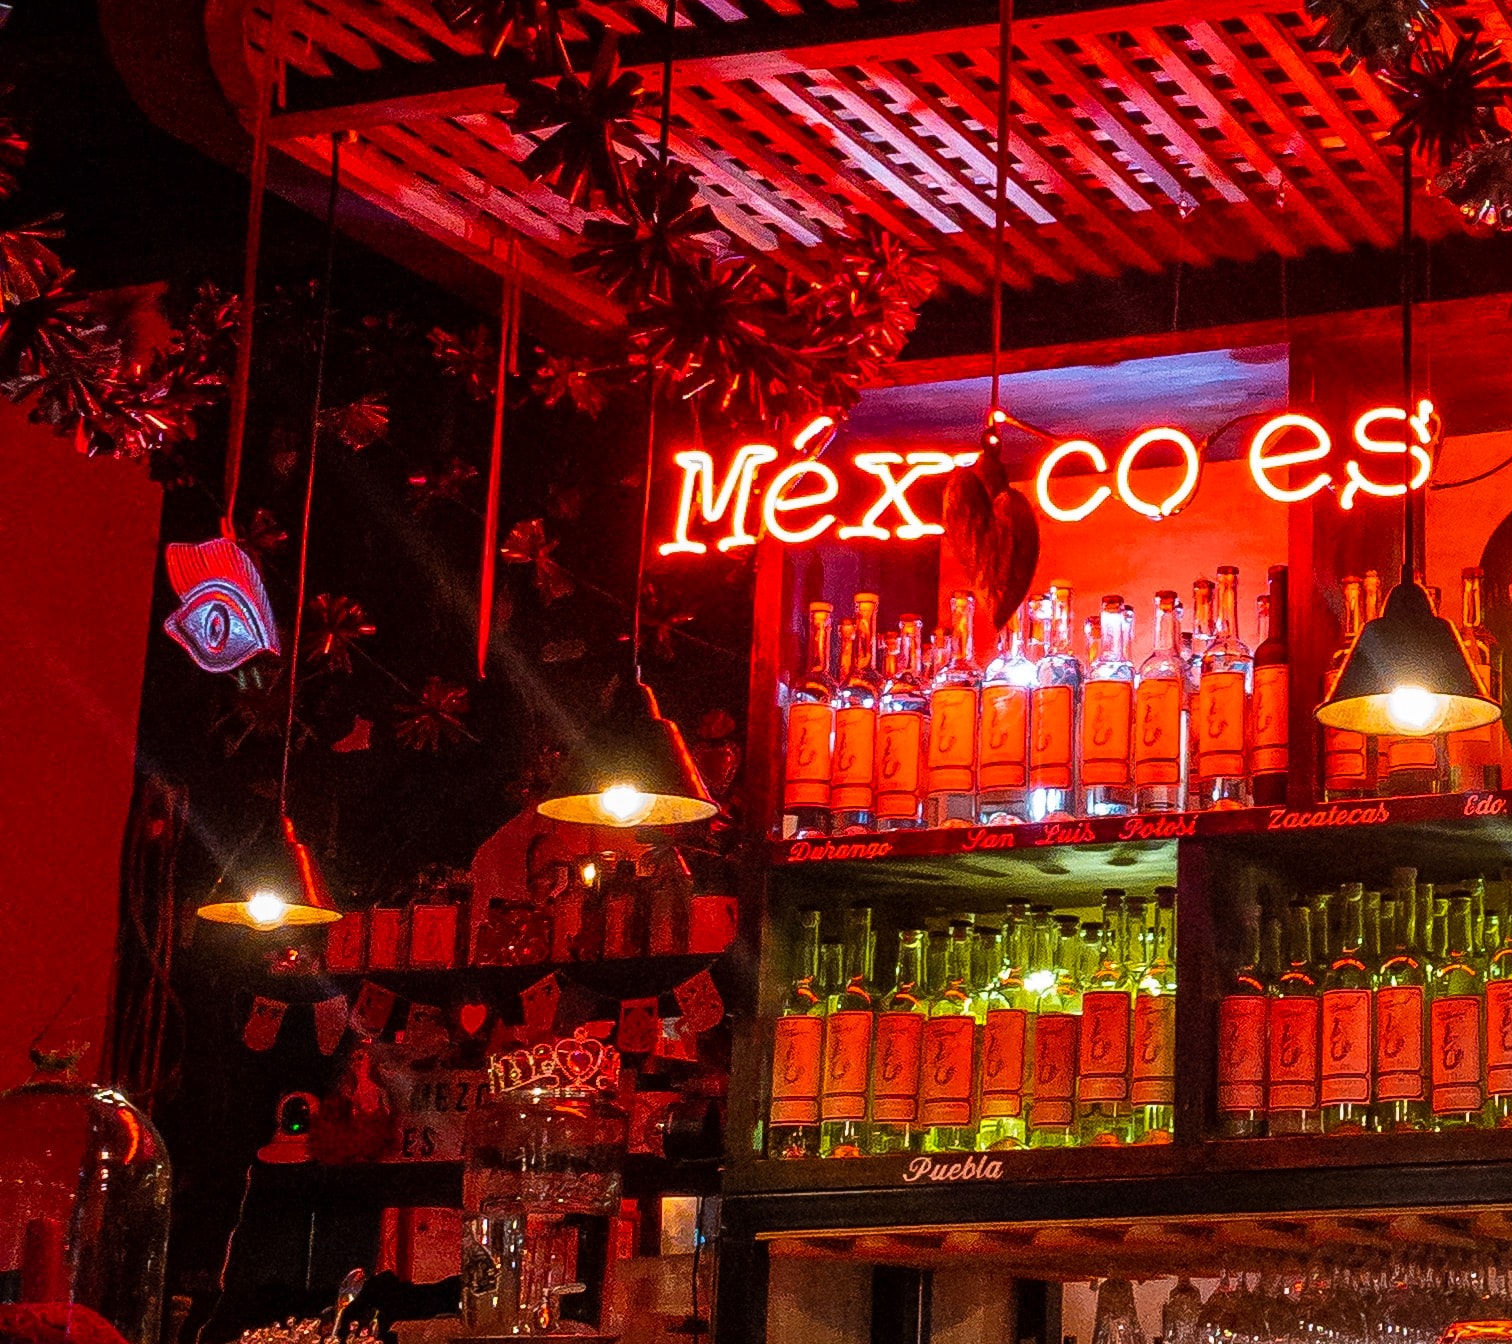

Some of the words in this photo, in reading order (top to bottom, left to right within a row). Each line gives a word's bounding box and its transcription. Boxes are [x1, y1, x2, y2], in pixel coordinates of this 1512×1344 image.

[657, 413, 1203, 556] Méxco
[1248, 398, 1437, 512] es
[1267, 803, 1391, 829] Zacatecas
[962, 828, 1016, 852] San
[1034, 819, 1096, 845] Luis
[1118, 812, 1198, 840] Potosí
[786, 840, 894, 863] Durango
[901, 1152, 1003, 1182] Puebla
